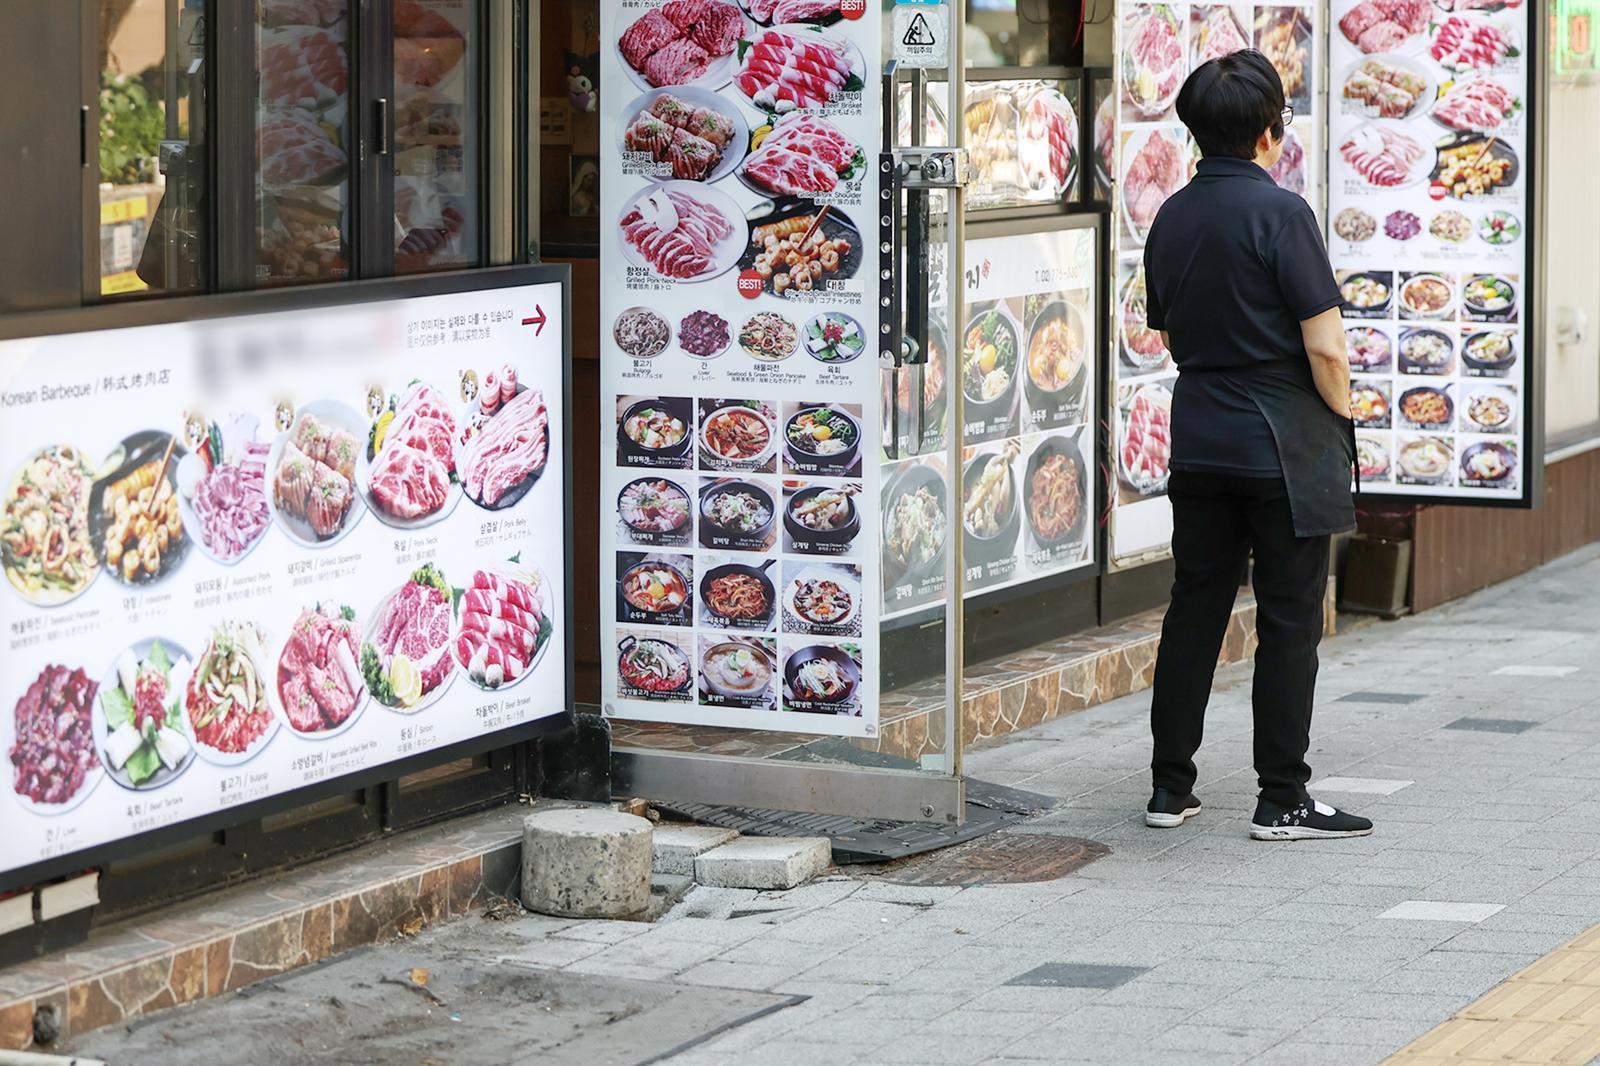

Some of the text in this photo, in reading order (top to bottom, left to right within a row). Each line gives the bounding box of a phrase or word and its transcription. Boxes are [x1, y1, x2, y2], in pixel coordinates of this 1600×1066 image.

[840, 1, 864, 11] BEST!
[739, 279, 762, 289] BEST!
[420, 318, 447, 331] 이미지는
[448, 315, 466, 328] 실제와
[467, 313, 479, 325] 다를
[490, 308, 514, 323] 있습니다
[701, 362, 708, 370] 간
[1, 390, 38, 407] Korean
[41, 383, 92, 402] Barbeque
[480, 520, 498, 535] 삼겹살
[792, 541, 809, 551] 삼계탕
[287, 559, 314, 575] 돼지갈비
[630, 611, 647, 620] 순두부
[220, 775, 243, 792] 불고기
